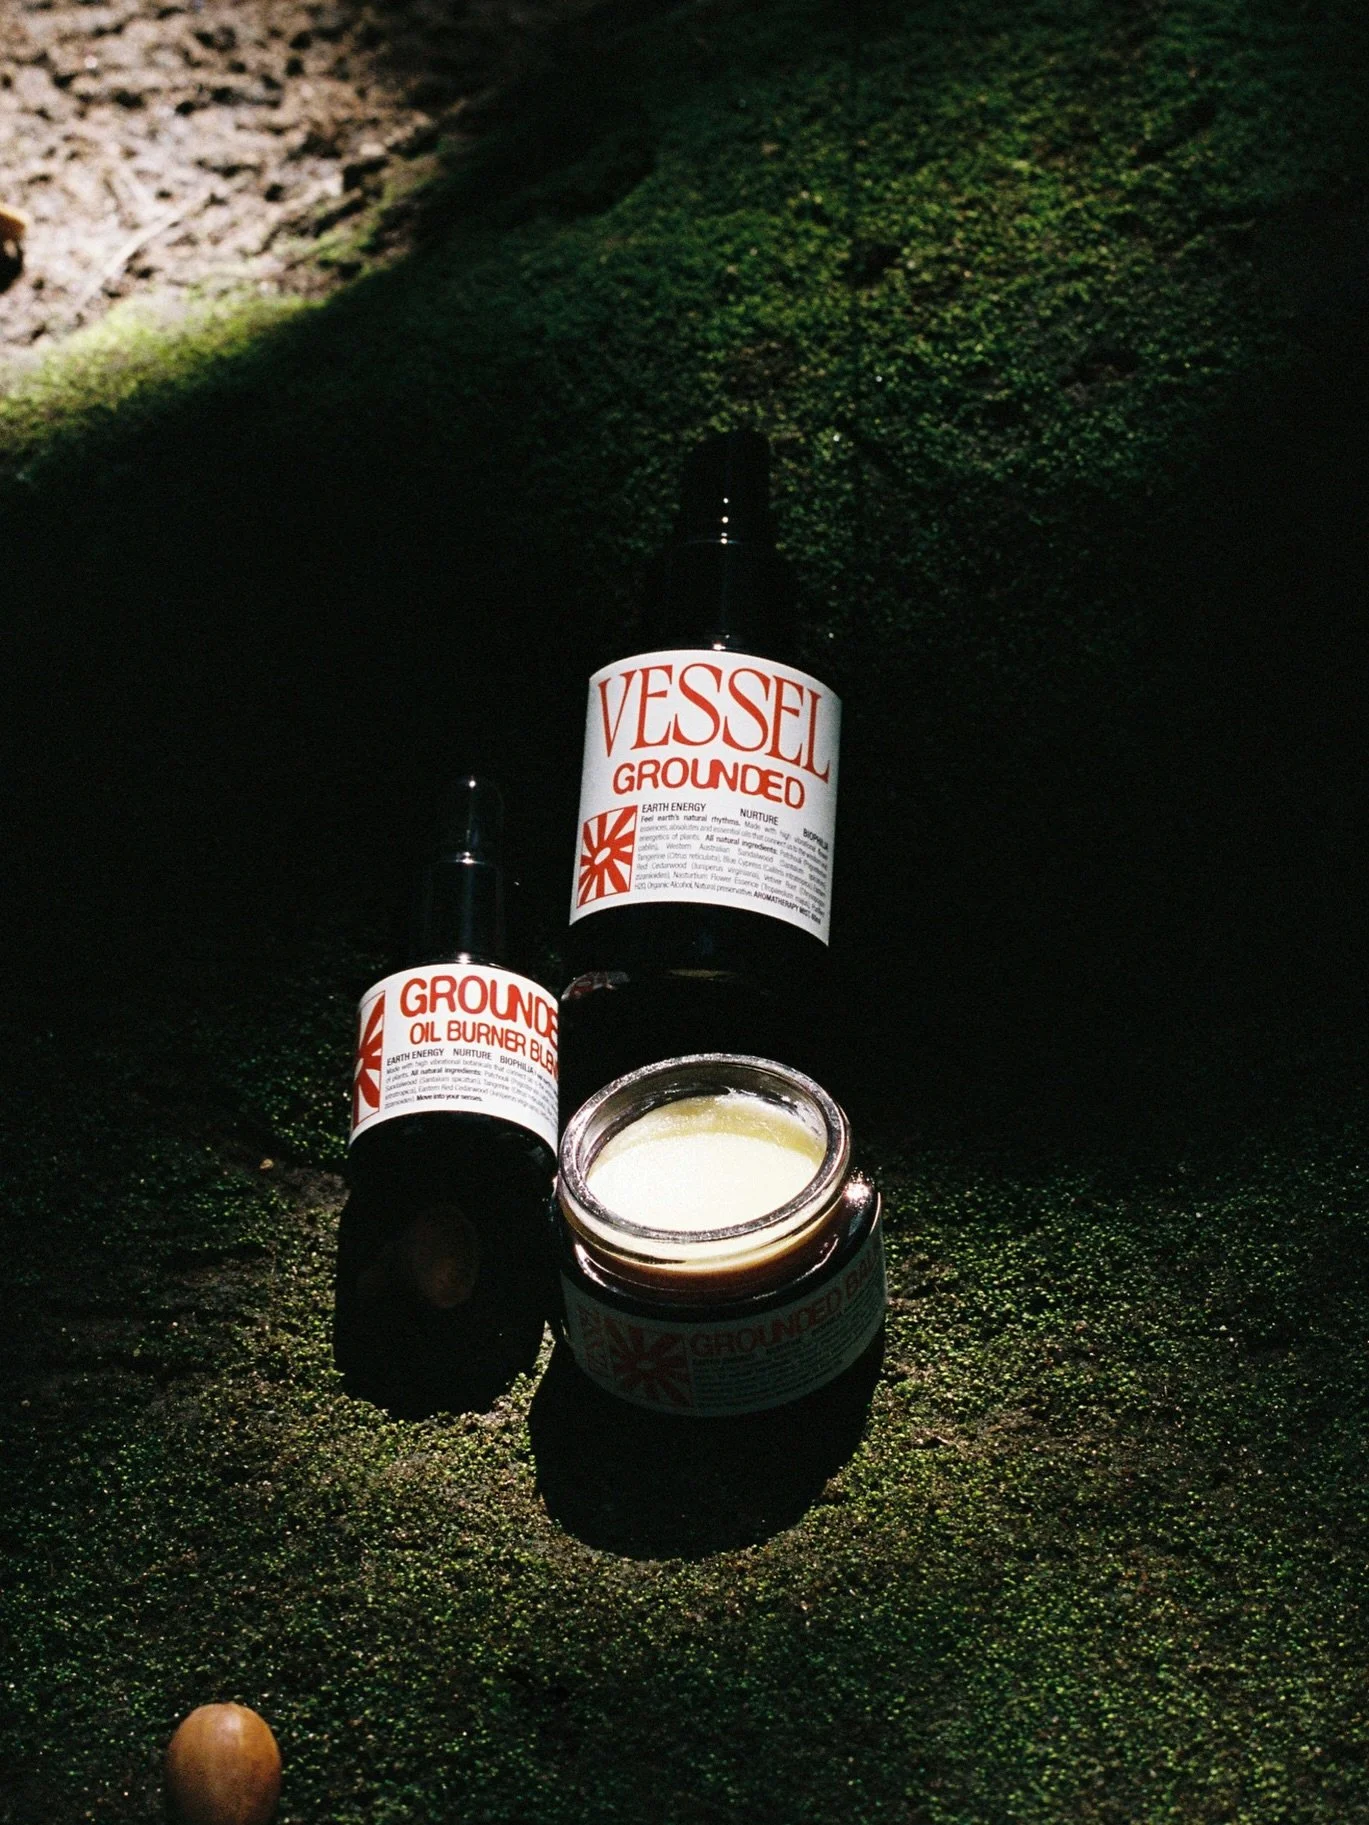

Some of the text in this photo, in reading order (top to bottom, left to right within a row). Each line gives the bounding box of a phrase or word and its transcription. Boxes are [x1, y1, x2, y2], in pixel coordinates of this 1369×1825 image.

[598, 663, 830, 784] VESSEL
[612, 757, 805, 810] GROUNDED
[642, 803, 669, 813] EARTH
[671, 802, 706, 812] ENERGY
[740, 808, 779, 826] NURTURE
[683, 814, 707, 822] natural
[711, 816, 740, 826] rhythms.
[716, 836, 740, 845] natural
[753, 891, 799, 912] AROMATHERAPY
[410, 1021, 441, 1045] OIL
[447, 1020, 526, 1056] BURNER
[386, 1048, 534, 1073] EARTH ENERGY NURTURE BIOPHILIA
[420, 1067, 443, 1075] natural
[461, 1094, 482, 1102] senses.
[689, 1287, 842, 1356] GROUNDED
